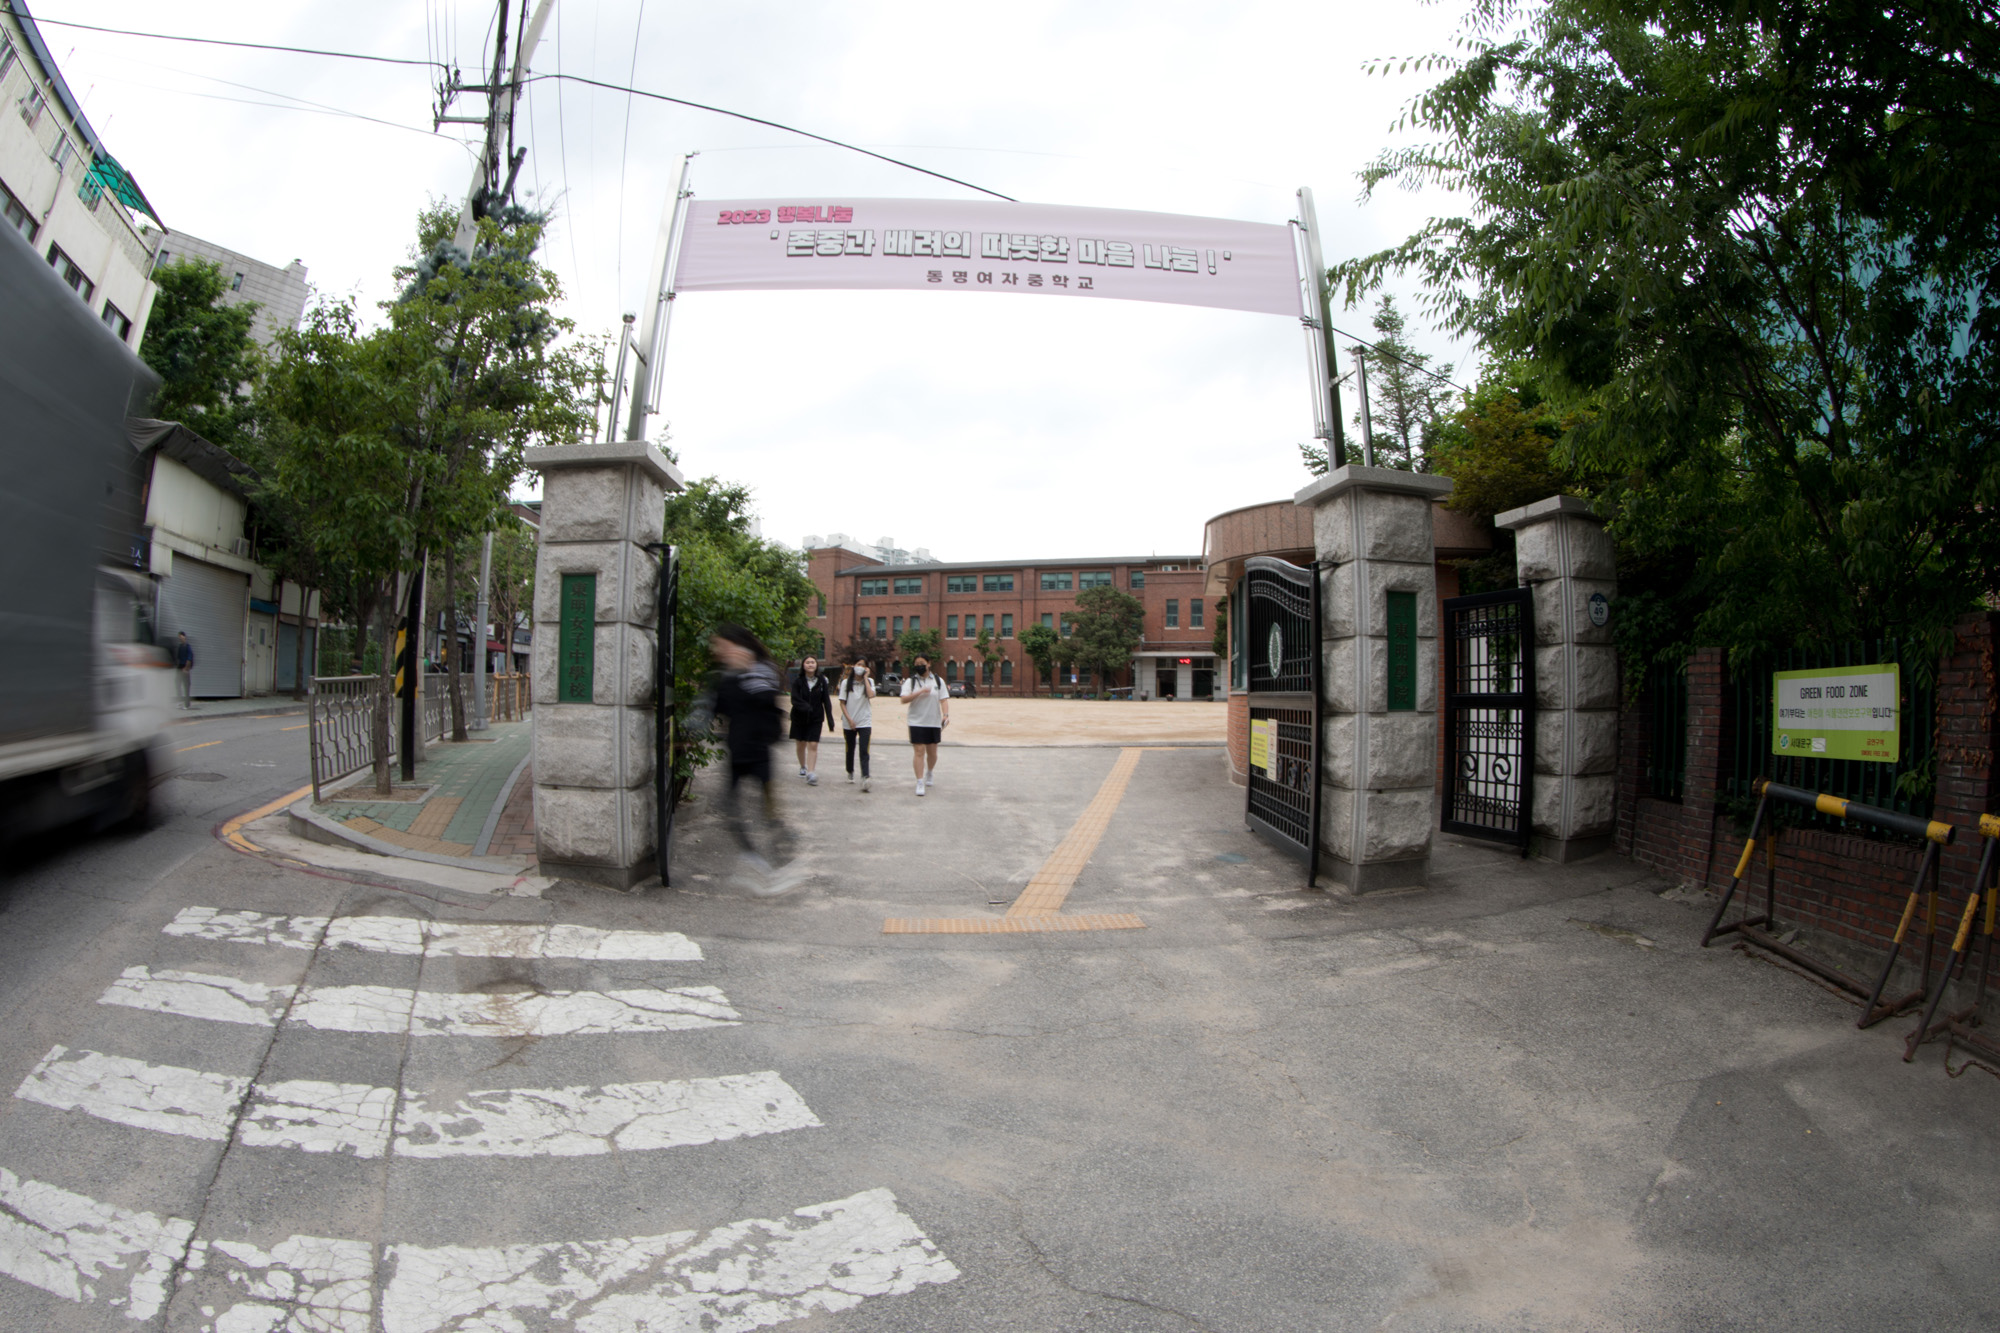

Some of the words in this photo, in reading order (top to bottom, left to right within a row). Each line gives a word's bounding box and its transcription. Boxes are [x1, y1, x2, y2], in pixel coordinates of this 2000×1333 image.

[717, 209, 771, 224] 2023
[777, 205, 854, 223] 행복나눔
[883, 230, 972, 259] 배려의
[981, 232, 1070, 263] 따뜻한
[1077, 238, 1135, 268] 마음
[1594, 607, 1604, 616] 49
[568, 581, 588, 698] 東明女子中學校
[1800, 687, 1822, 699] GREEN
[1826, 686, 1845, 698] FOOD
[1849, 685, 1868, 697] ZONE
[1779, 708, 1806, 718] 여기부터는
[1791, 738, 1811, 749] 서대문구
